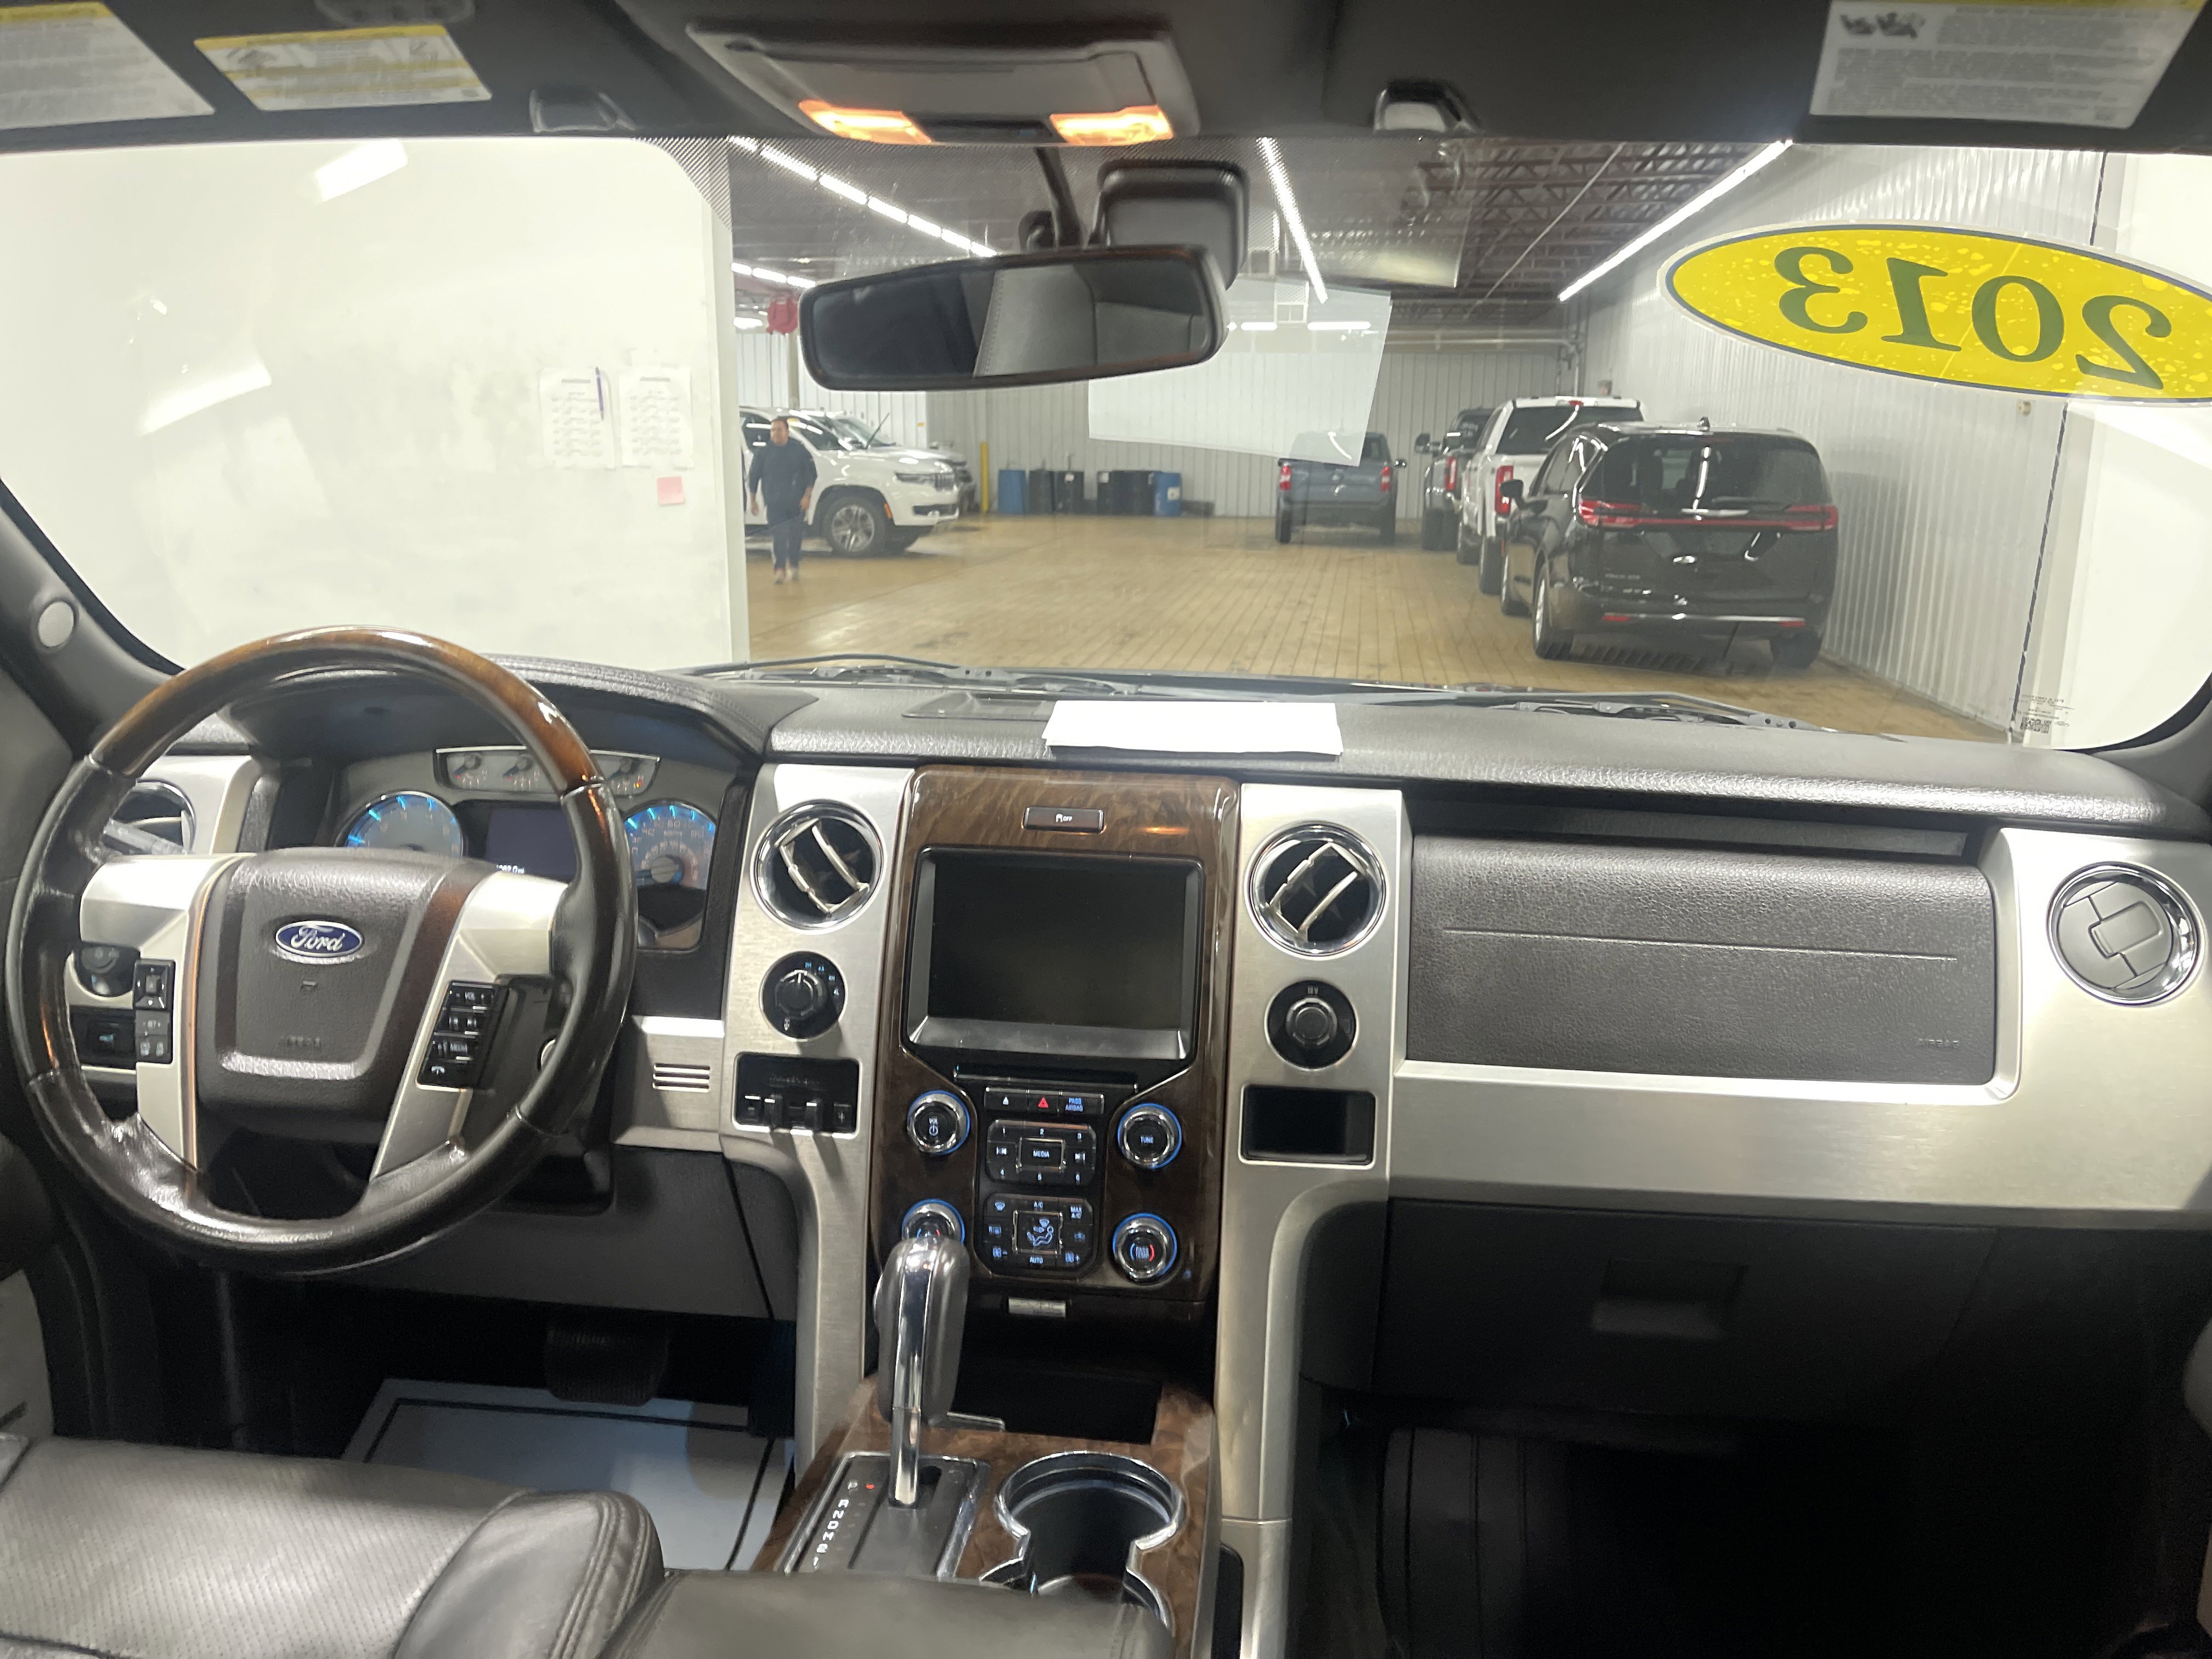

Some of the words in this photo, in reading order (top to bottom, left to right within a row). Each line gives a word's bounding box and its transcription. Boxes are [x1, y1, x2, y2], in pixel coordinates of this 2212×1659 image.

[290, 923, 346, 952] Ford
[1140, 1136, 1154, 1144] TUNE
[1033, 1150, 1050, 1158] MEDIA
[1029, 1256, 1043, 1264] AUTO
[832, 1510, 844, 1519] N
[827, 1520, 839, 1530] D
